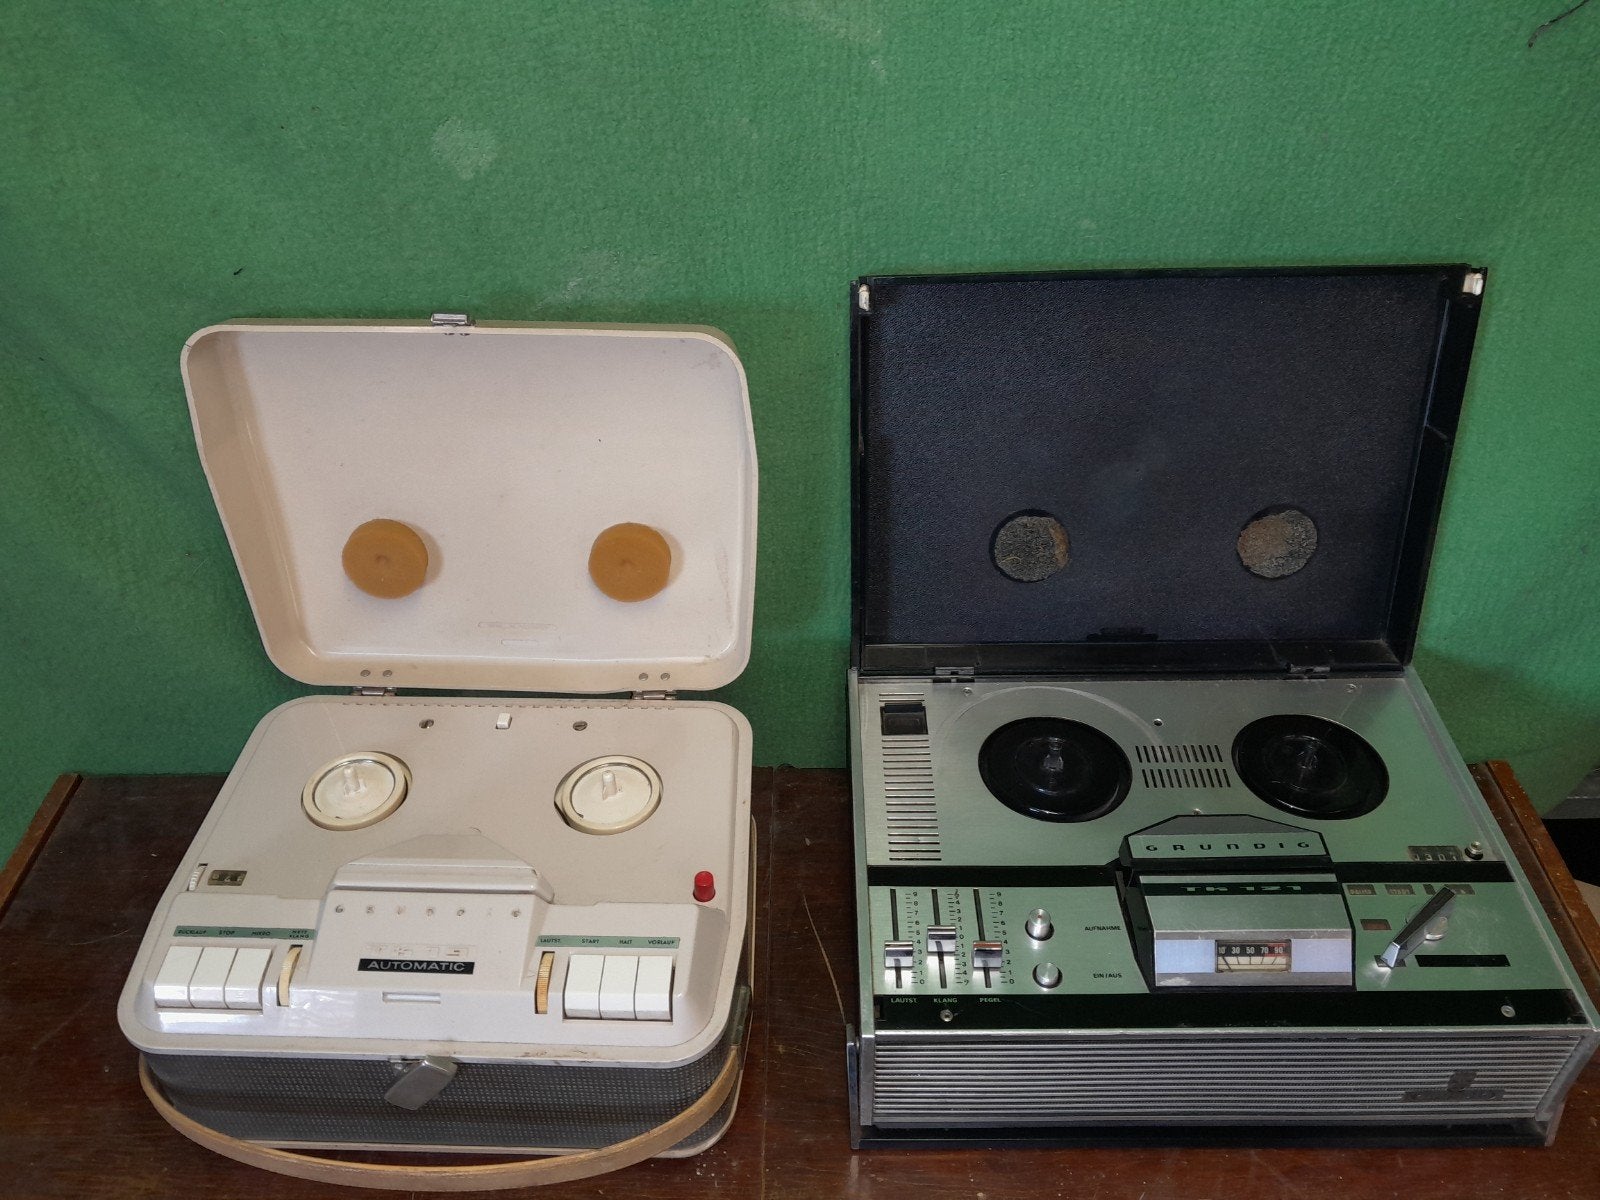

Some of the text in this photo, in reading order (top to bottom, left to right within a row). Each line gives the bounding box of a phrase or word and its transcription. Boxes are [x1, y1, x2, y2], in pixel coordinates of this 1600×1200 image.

[1145, 842, 1310, 852] GRUNDIG
[1231, 946, 1241, 955] 30
[1245, 946, 1256, 955] 50
[1260, 946, 1270, 955] 70
[1274, 946, 1284, 955] 90
[367, 960, 466, 972] AUTOMATIC
